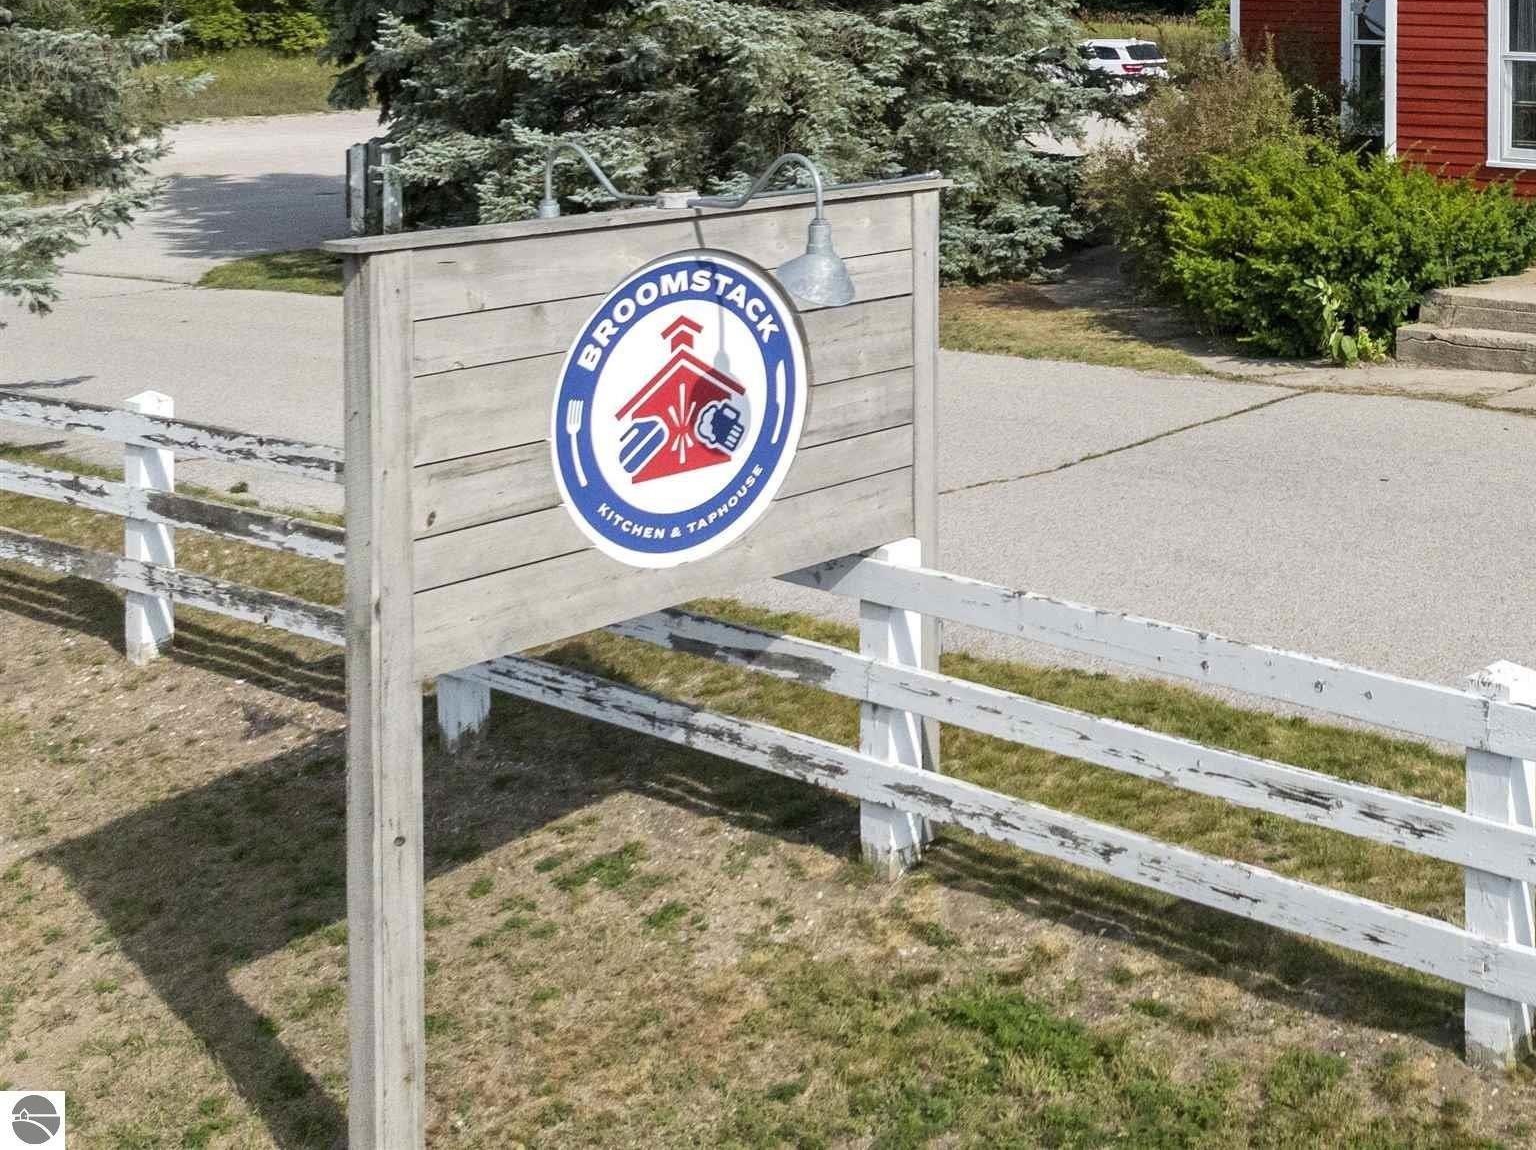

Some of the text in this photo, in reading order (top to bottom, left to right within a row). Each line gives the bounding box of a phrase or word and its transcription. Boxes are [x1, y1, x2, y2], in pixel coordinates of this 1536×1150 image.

[577, 269, 781, 373] BROOMSTACK
[597, 463, 764, 539] KITCHEN & TAPHOUSE
